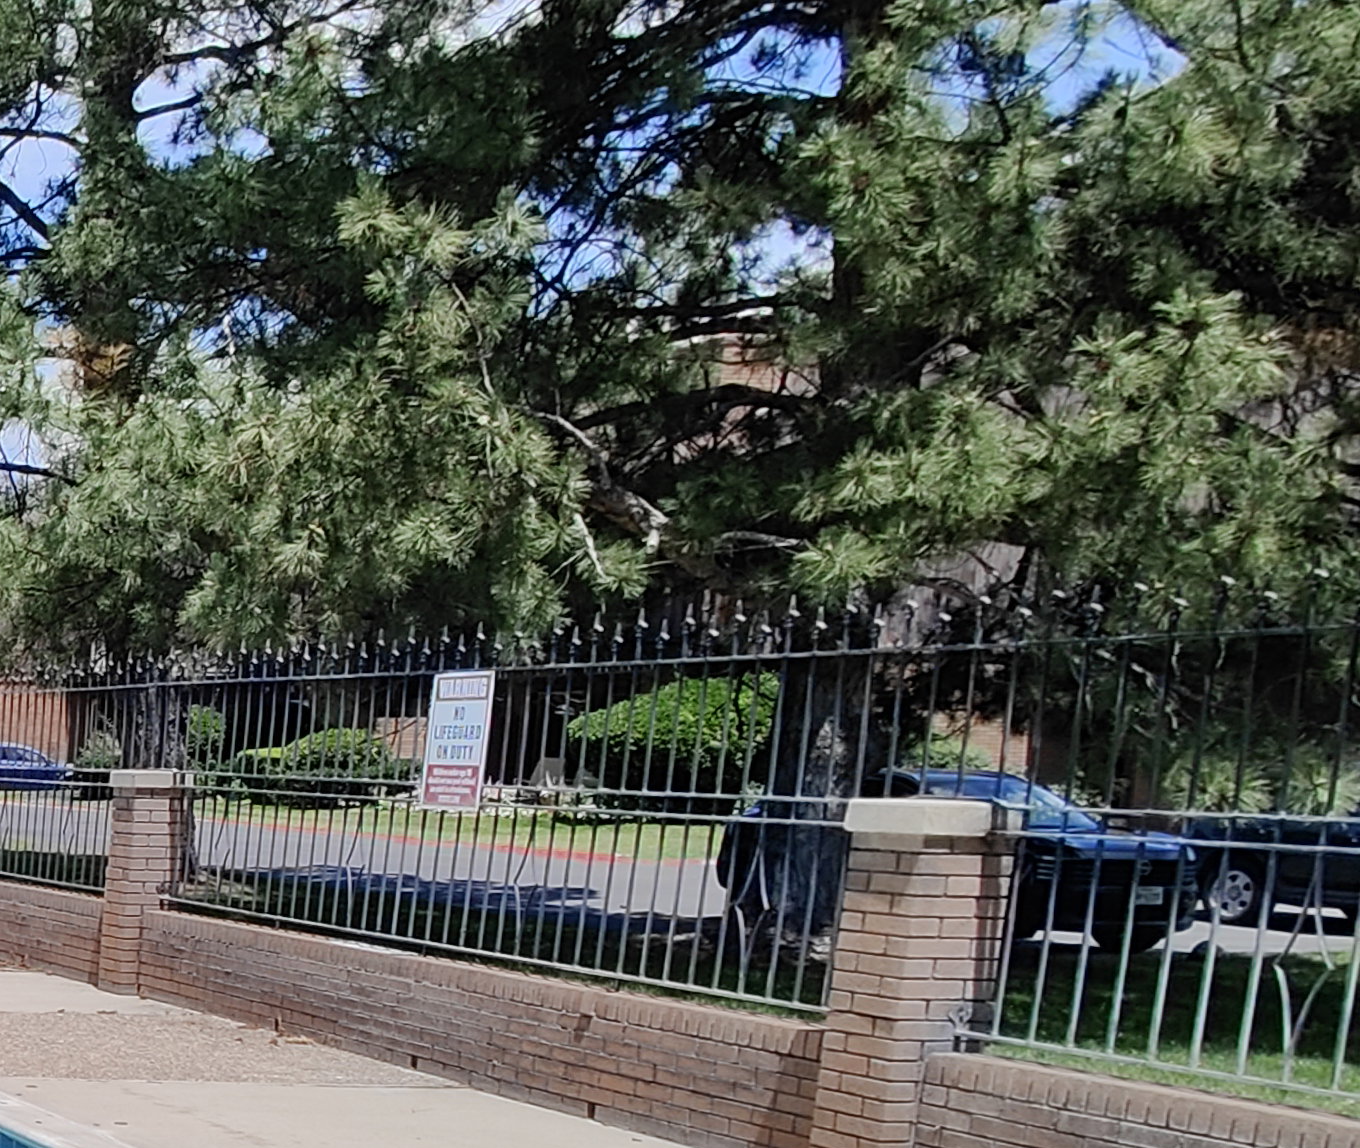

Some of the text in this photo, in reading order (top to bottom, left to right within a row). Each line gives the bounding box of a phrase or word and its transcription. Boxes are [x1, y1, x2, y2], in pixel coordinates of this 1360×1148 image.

[453, 706, 465, 720] NO
[434, 725, 482, 740] LIFEGUARD
[436, 744, 474, 760] ON DUTY
